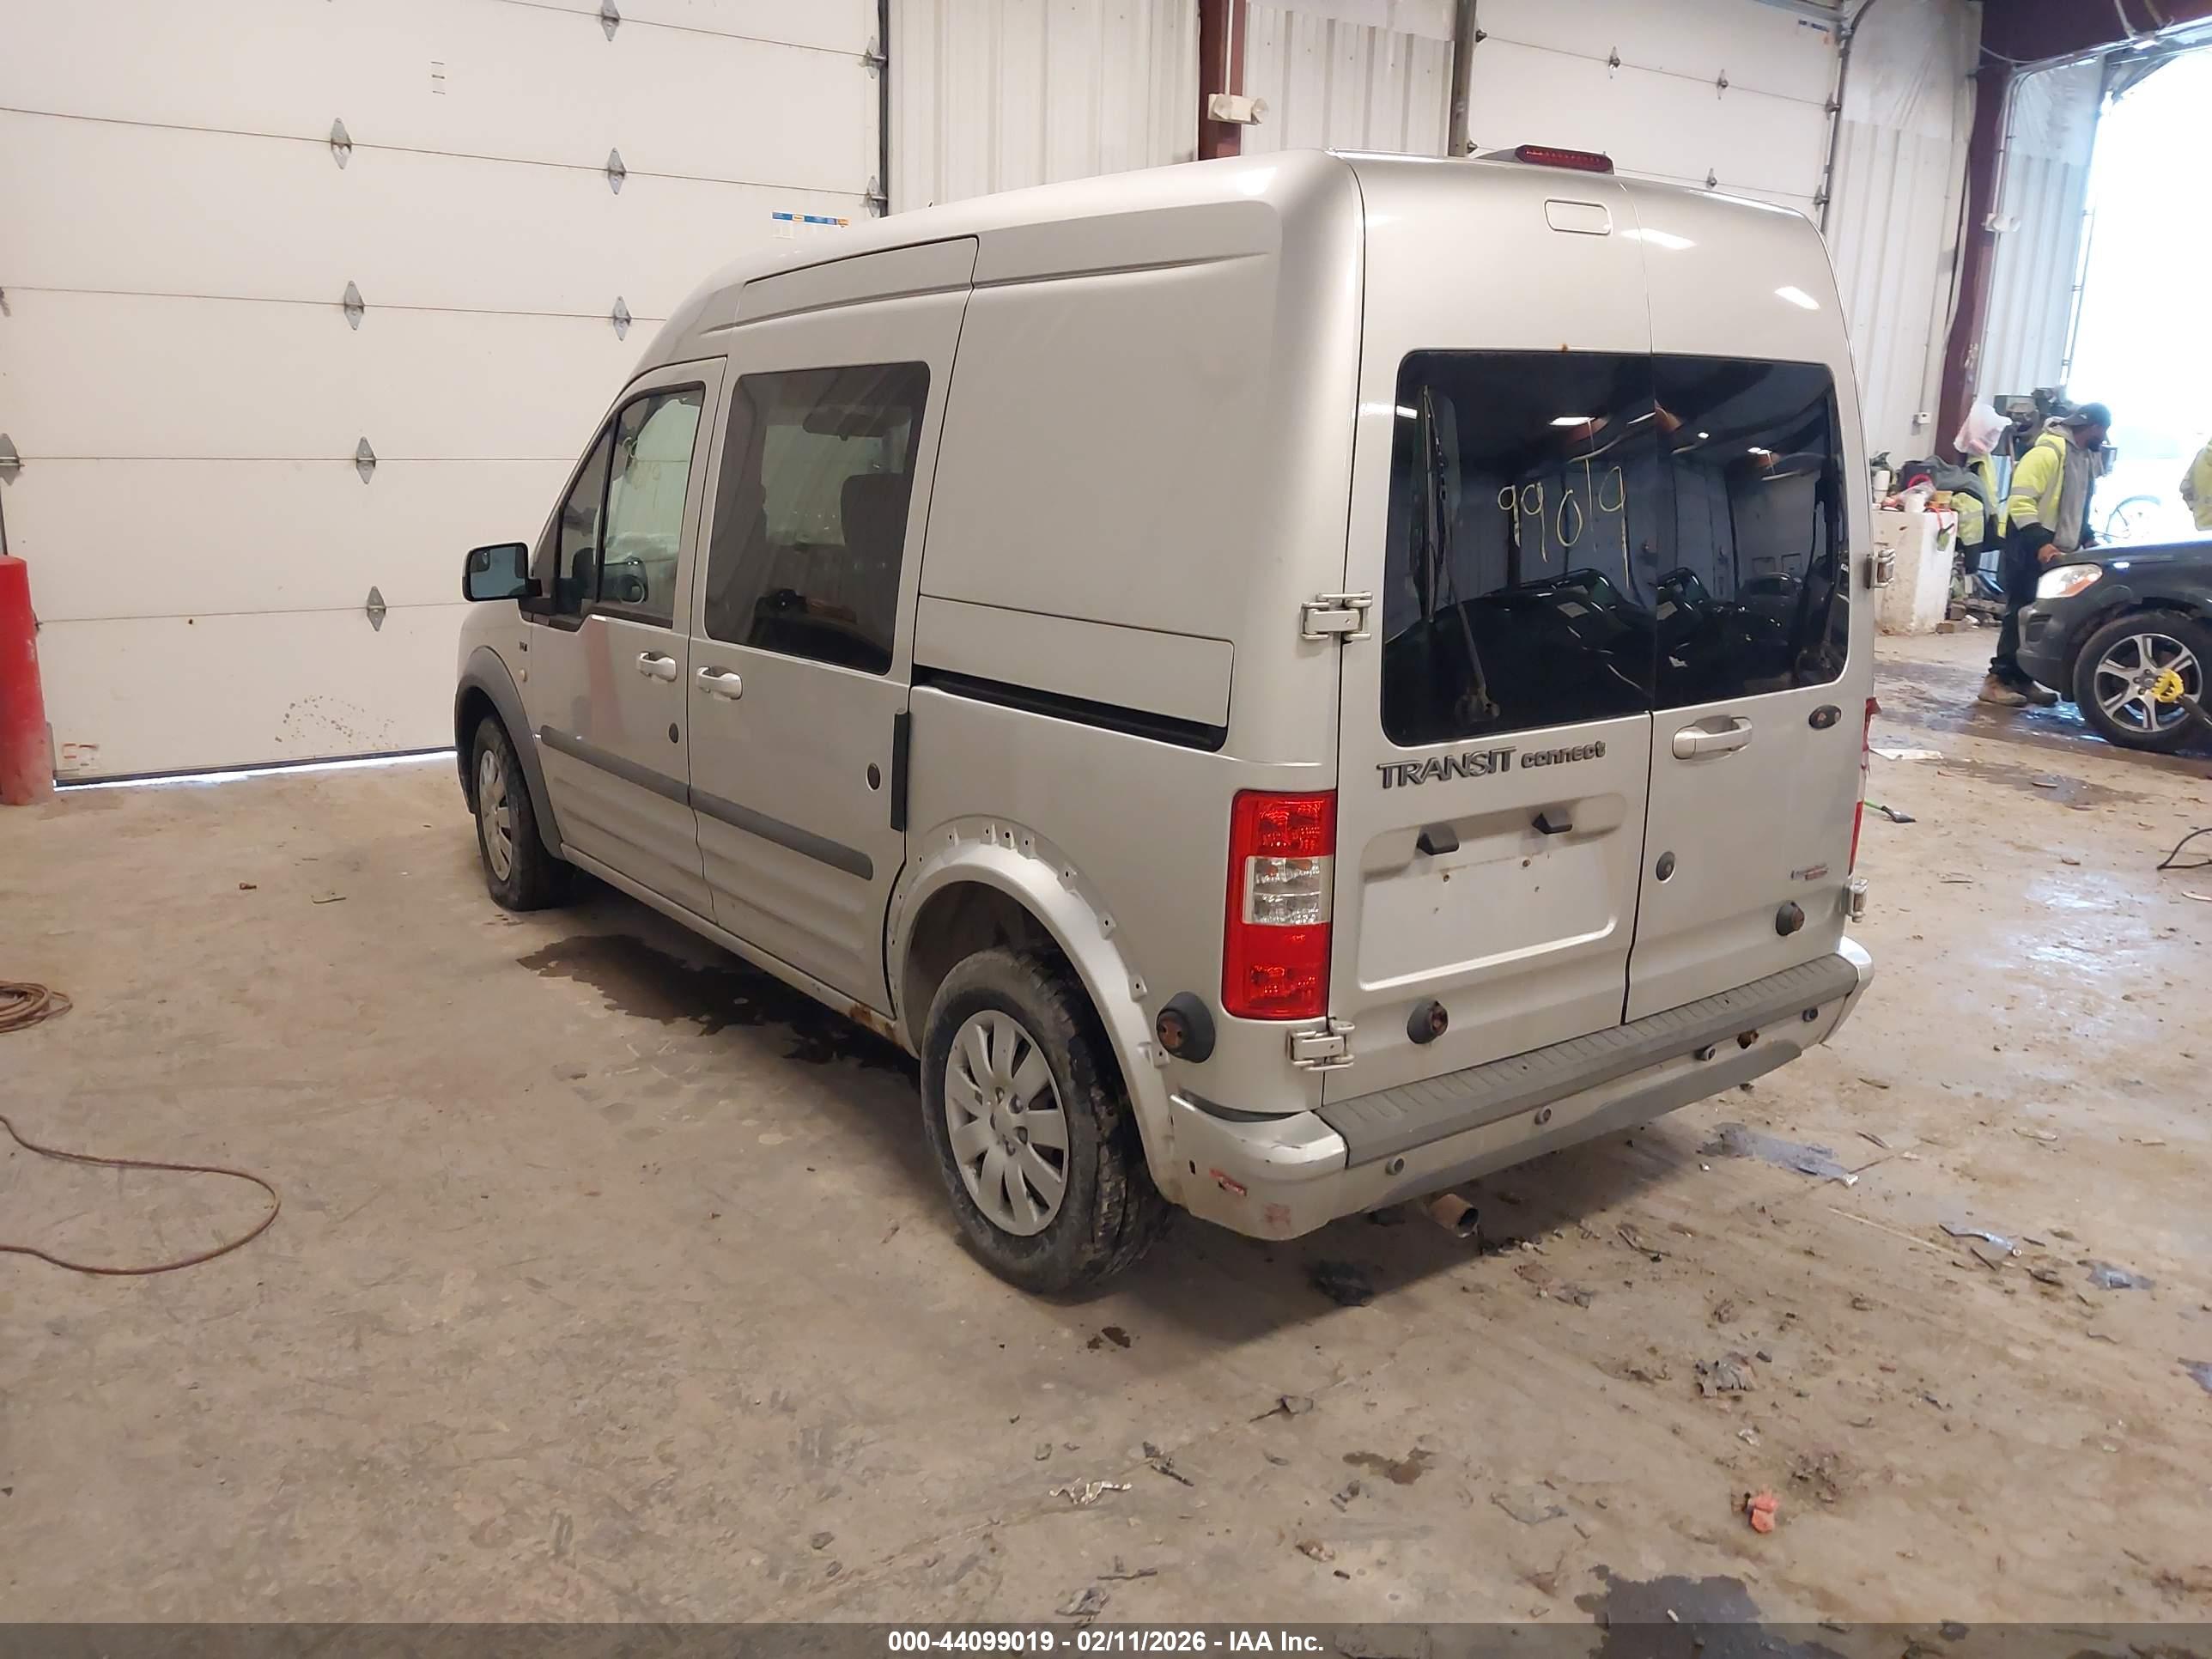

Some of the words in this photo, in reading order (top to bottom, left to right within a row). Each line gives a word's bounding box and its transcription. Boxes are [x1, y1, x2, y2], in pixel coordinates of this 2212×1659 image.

[1498, 458, 1630, 589] 99019
[1376, 745, 1517, 789] TRANSIT
[1521, 740, 1606, 769] connect
